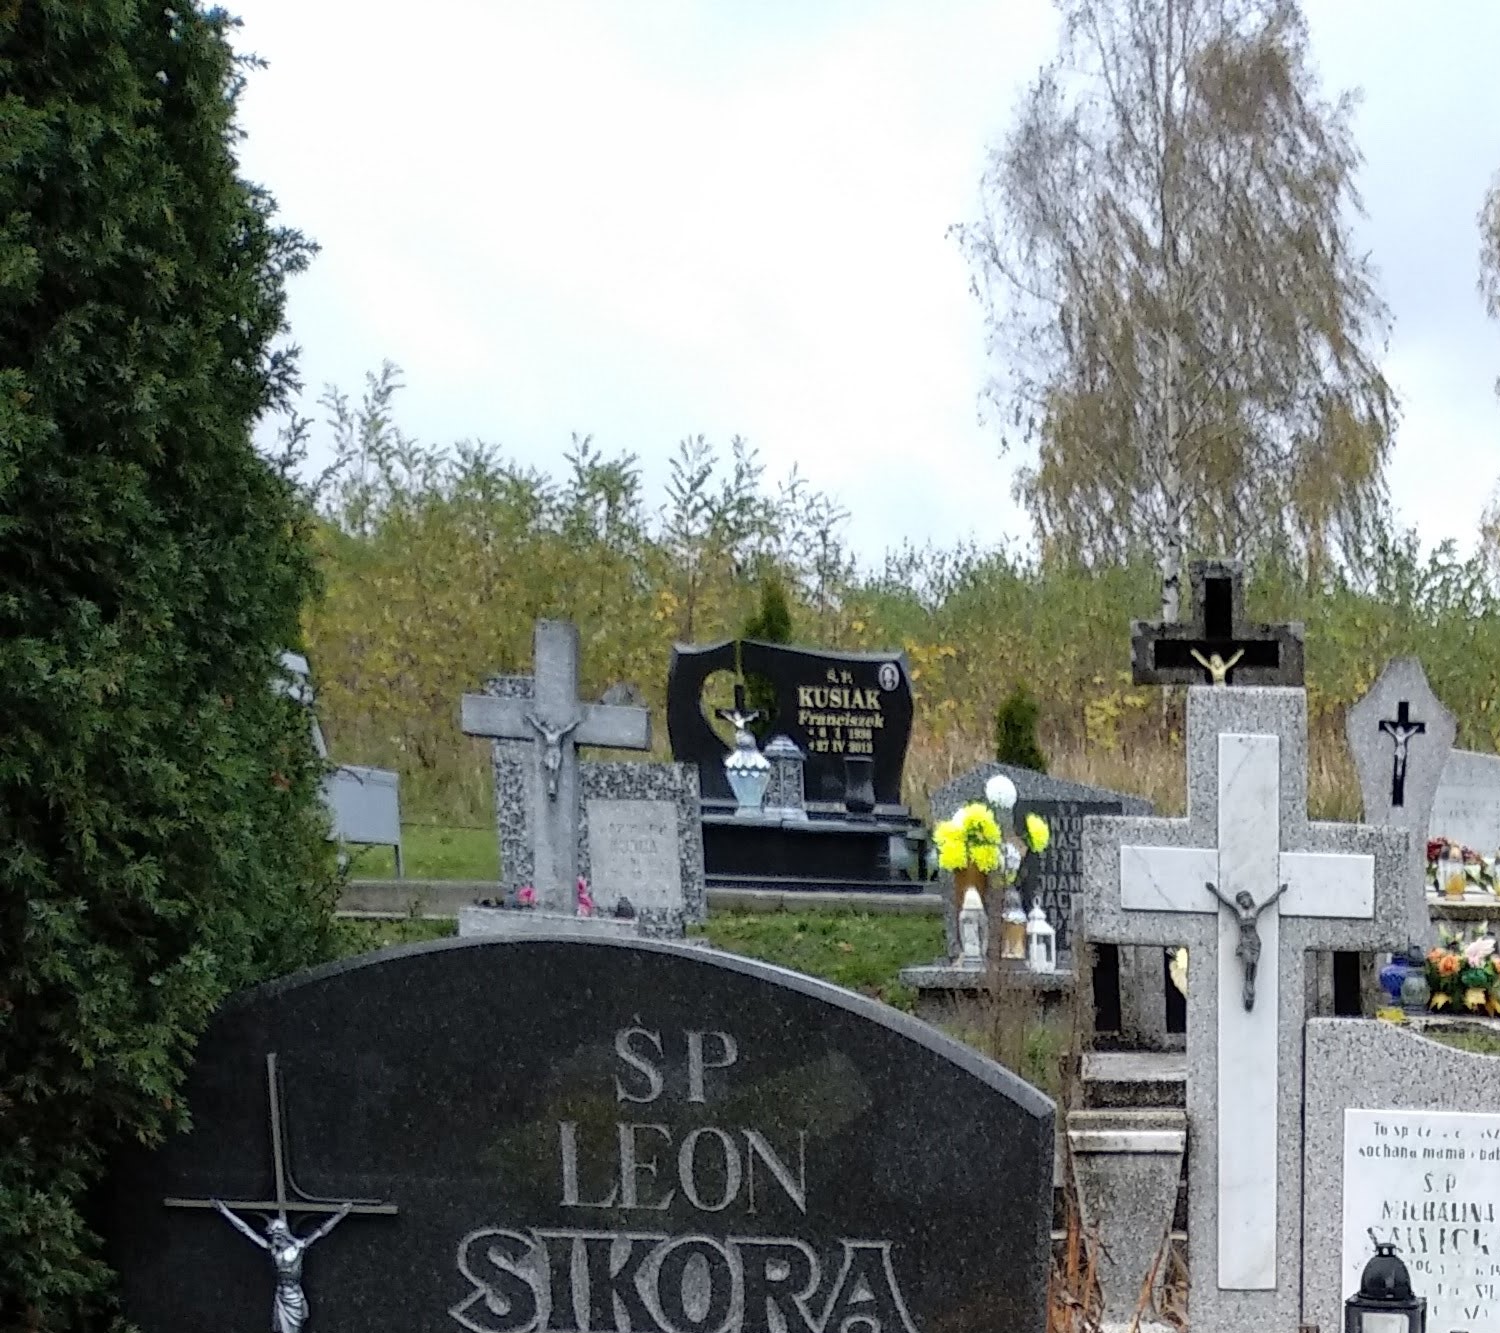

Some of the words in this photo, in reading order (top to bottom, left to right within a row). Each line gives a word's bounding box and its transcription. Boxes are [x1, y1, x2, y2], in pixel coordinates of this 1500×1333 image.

[798, 687, 882, 710] KUSIAK
[798, 710, 884, 728] Franciszek
[558, 1120, 807, 1214] LEON
